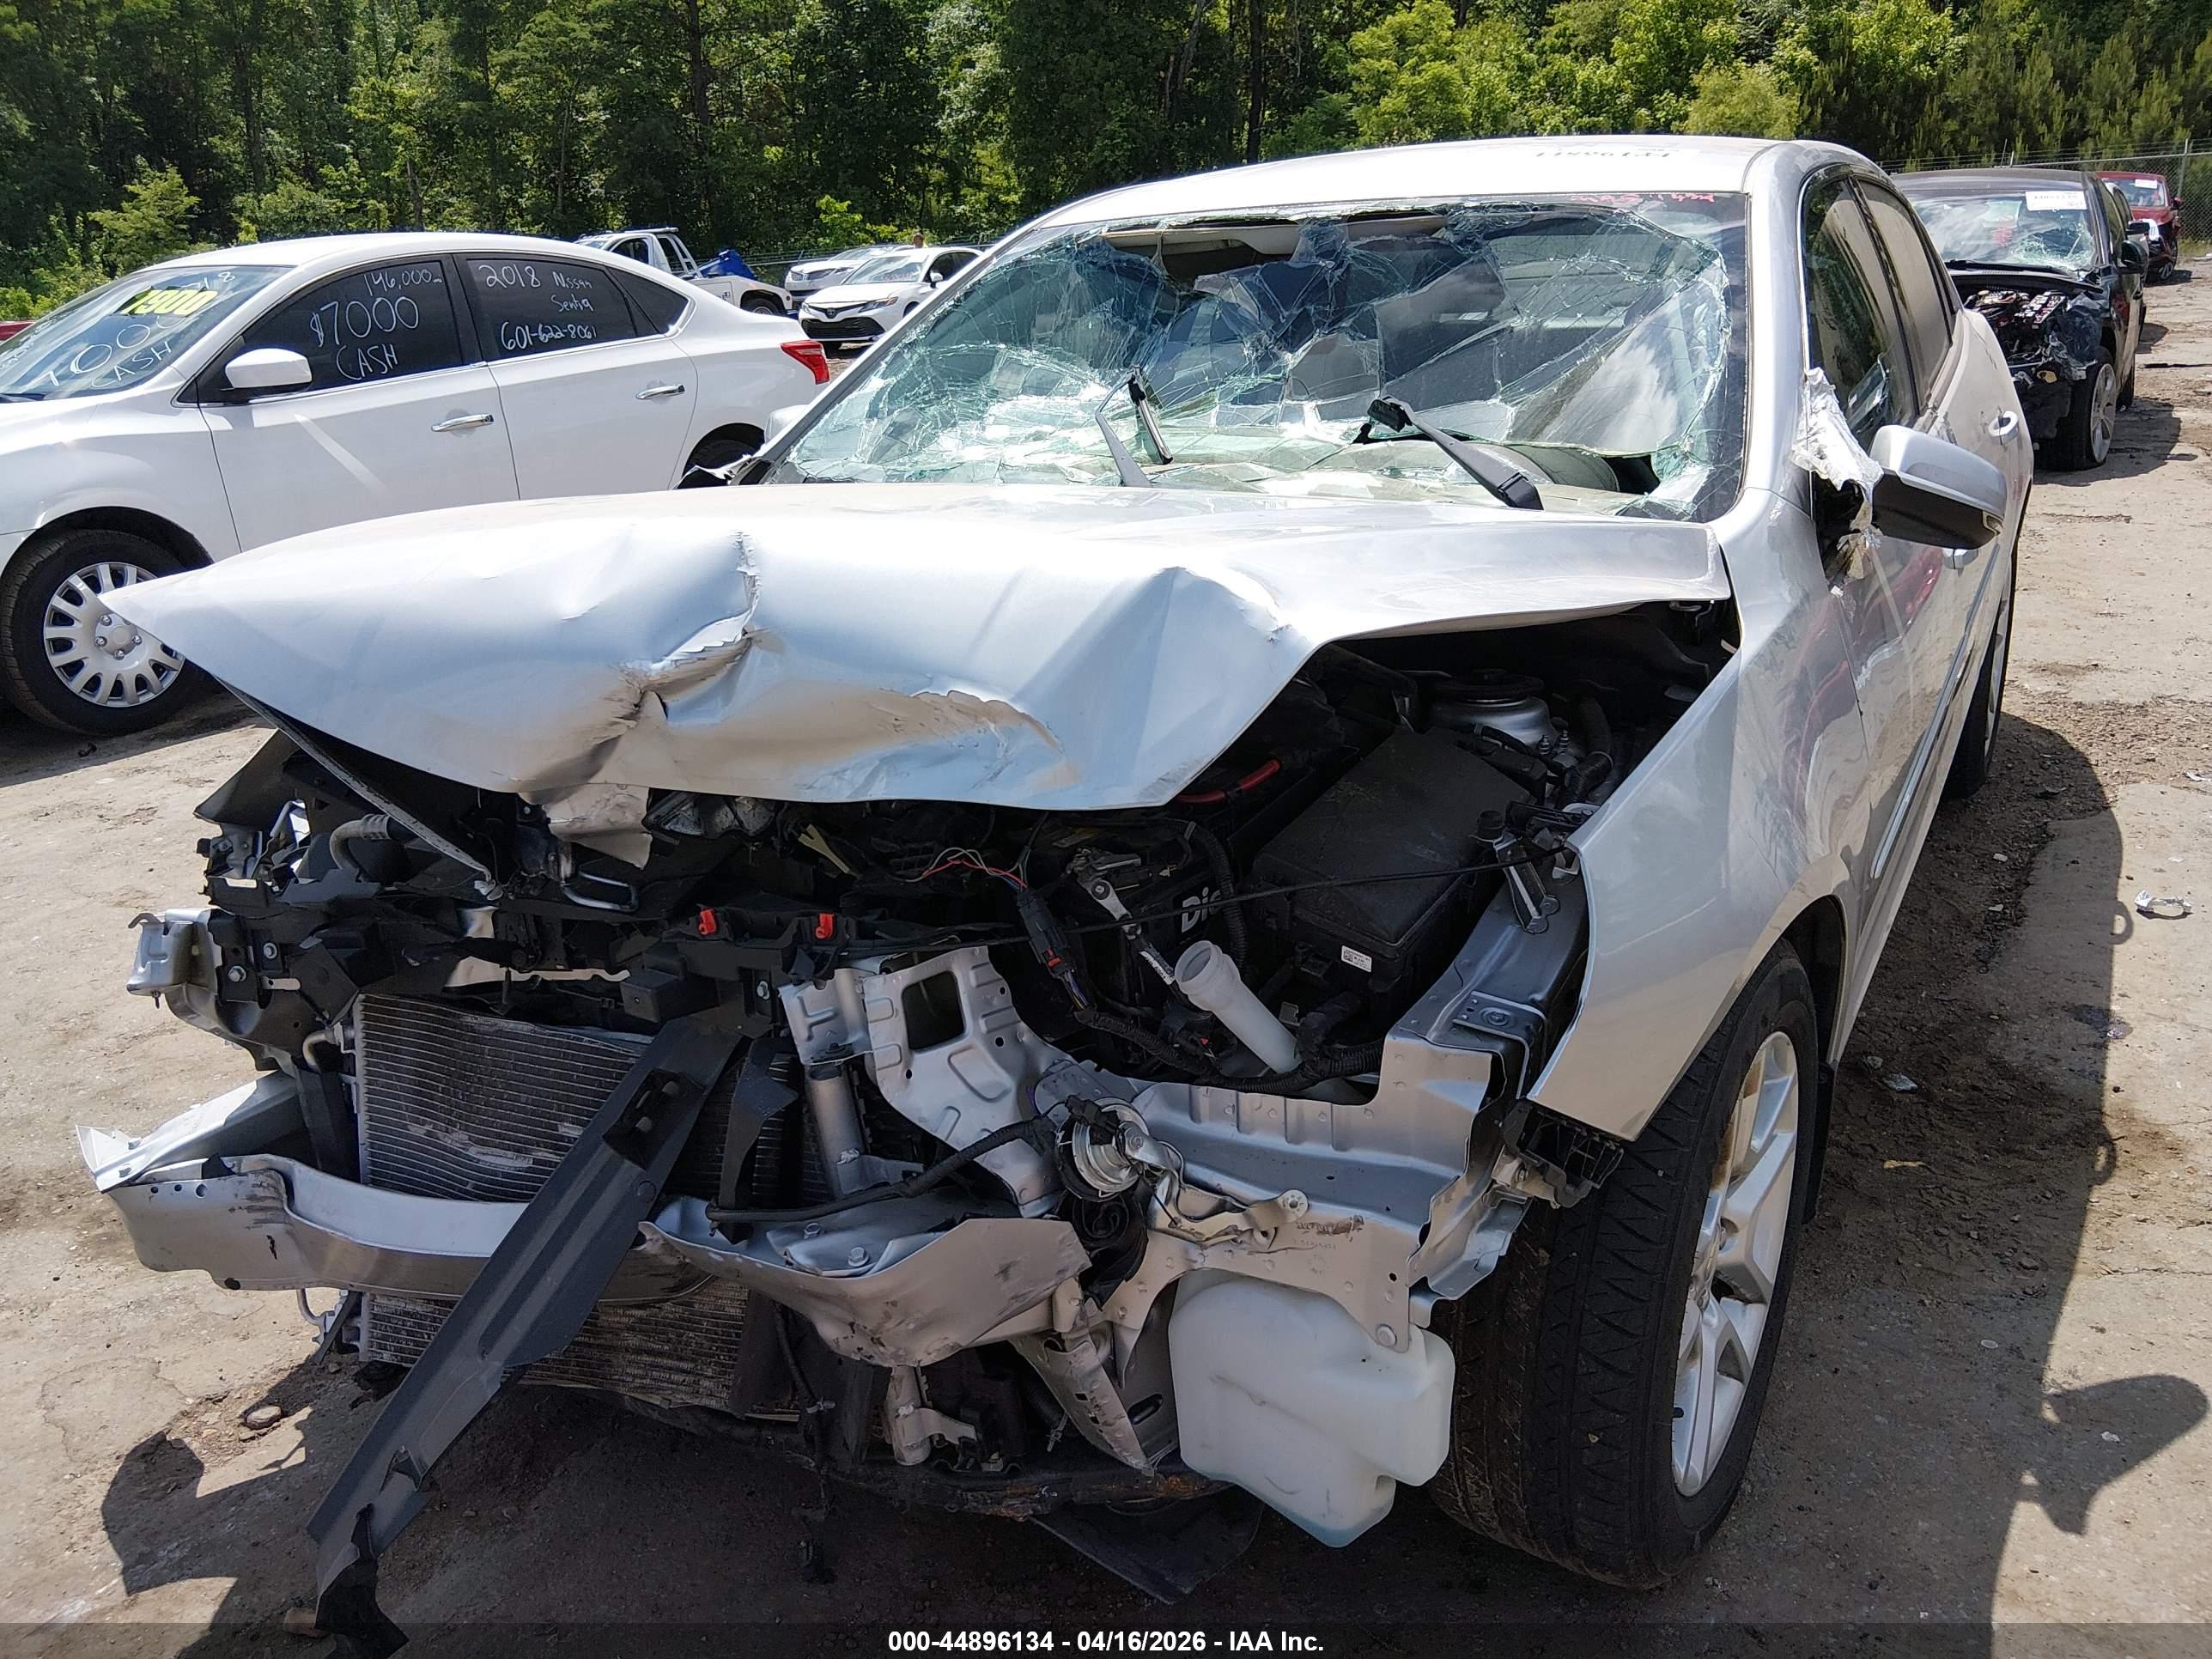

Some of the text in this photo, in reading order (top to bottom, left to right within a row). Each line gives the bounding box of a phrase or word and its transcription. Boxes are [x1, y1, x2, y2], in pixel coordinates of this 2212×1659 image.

[477, 263, 541, 289] 2018
[309, 296, 419, 348] $7000
[501, 321, 597, 350] 601-622-8061
[91, 341, 172, 388] CASH
[336, 343, 398, 380] CASH
